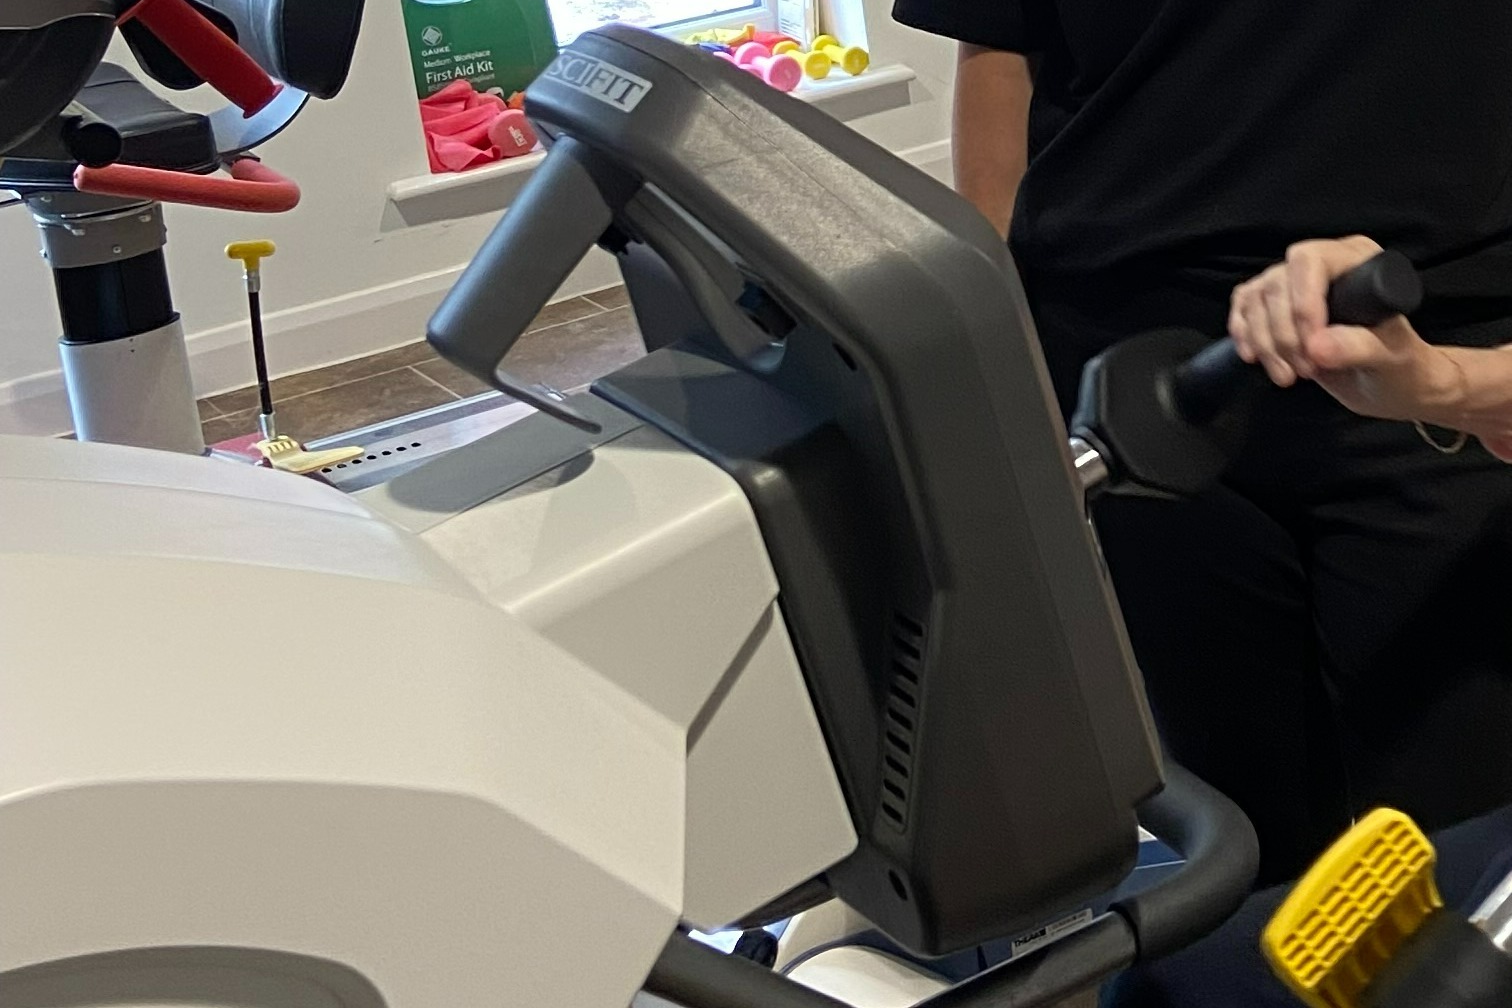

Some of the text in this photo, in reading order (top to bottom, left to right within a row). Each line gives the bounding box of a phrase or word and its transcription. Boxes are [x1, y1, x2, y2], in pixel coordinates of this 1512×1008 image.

[424, 50, 491, 68] Medium Workplace
[425, 69, 453, 84] First
[454, 62, 475, 78] Aid
[476, 60, 494, 73] Kit
[549, 54, 645, 105] SCIFIT
